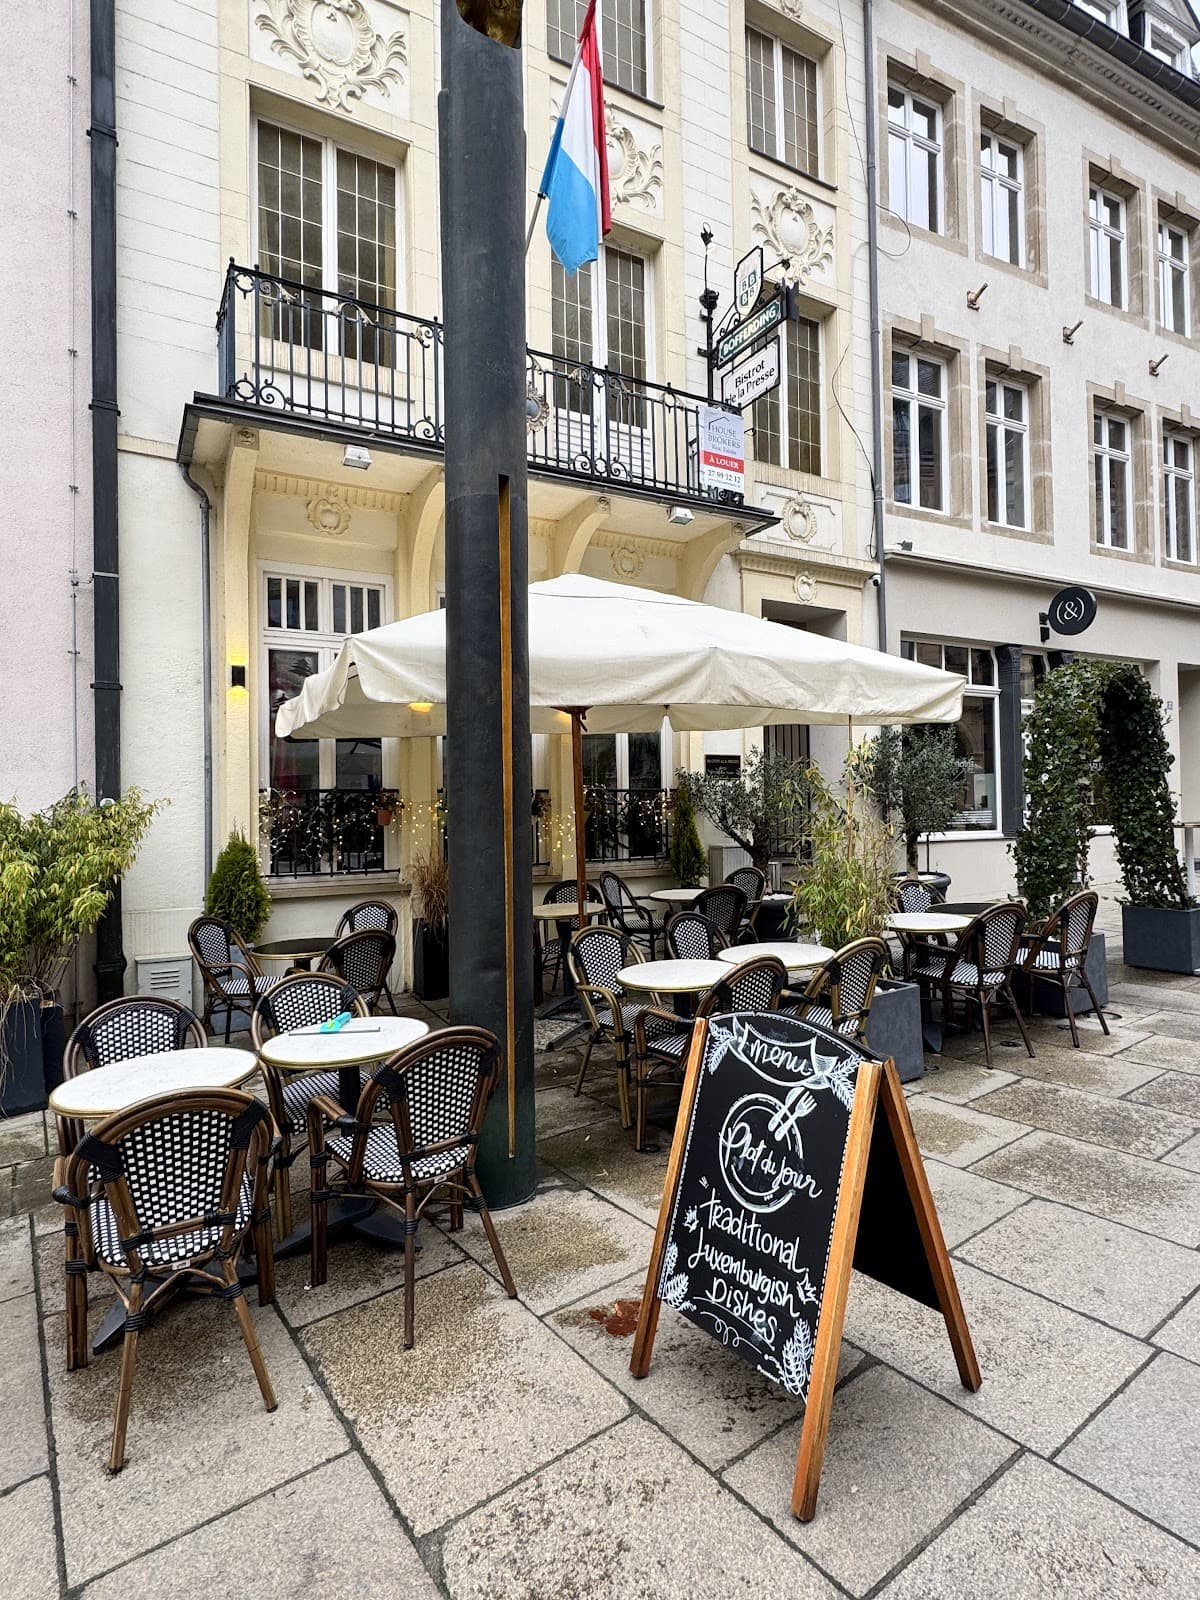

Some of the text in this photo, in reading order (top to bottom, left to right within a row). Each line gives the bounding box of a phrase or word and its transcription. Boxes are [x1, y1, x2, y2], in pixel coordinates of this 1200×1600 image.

[723, 305, 776, 356] BOFFERDING
[735, 360, 765, 388] Bistrot
[737, 388, 745, 400] la
[746, 367, 775, 393] Presse
[708, 433, 741, 449] BROKERS
[711, 425, 737, 438] HOUSE
[716, 457, 739, 470] LOUER
[750, 1038, 812, 1076] menu
[719, 1122, 823, 1198] Plat du jour
[687, 1227, 801, 1317] Luxemburgish
